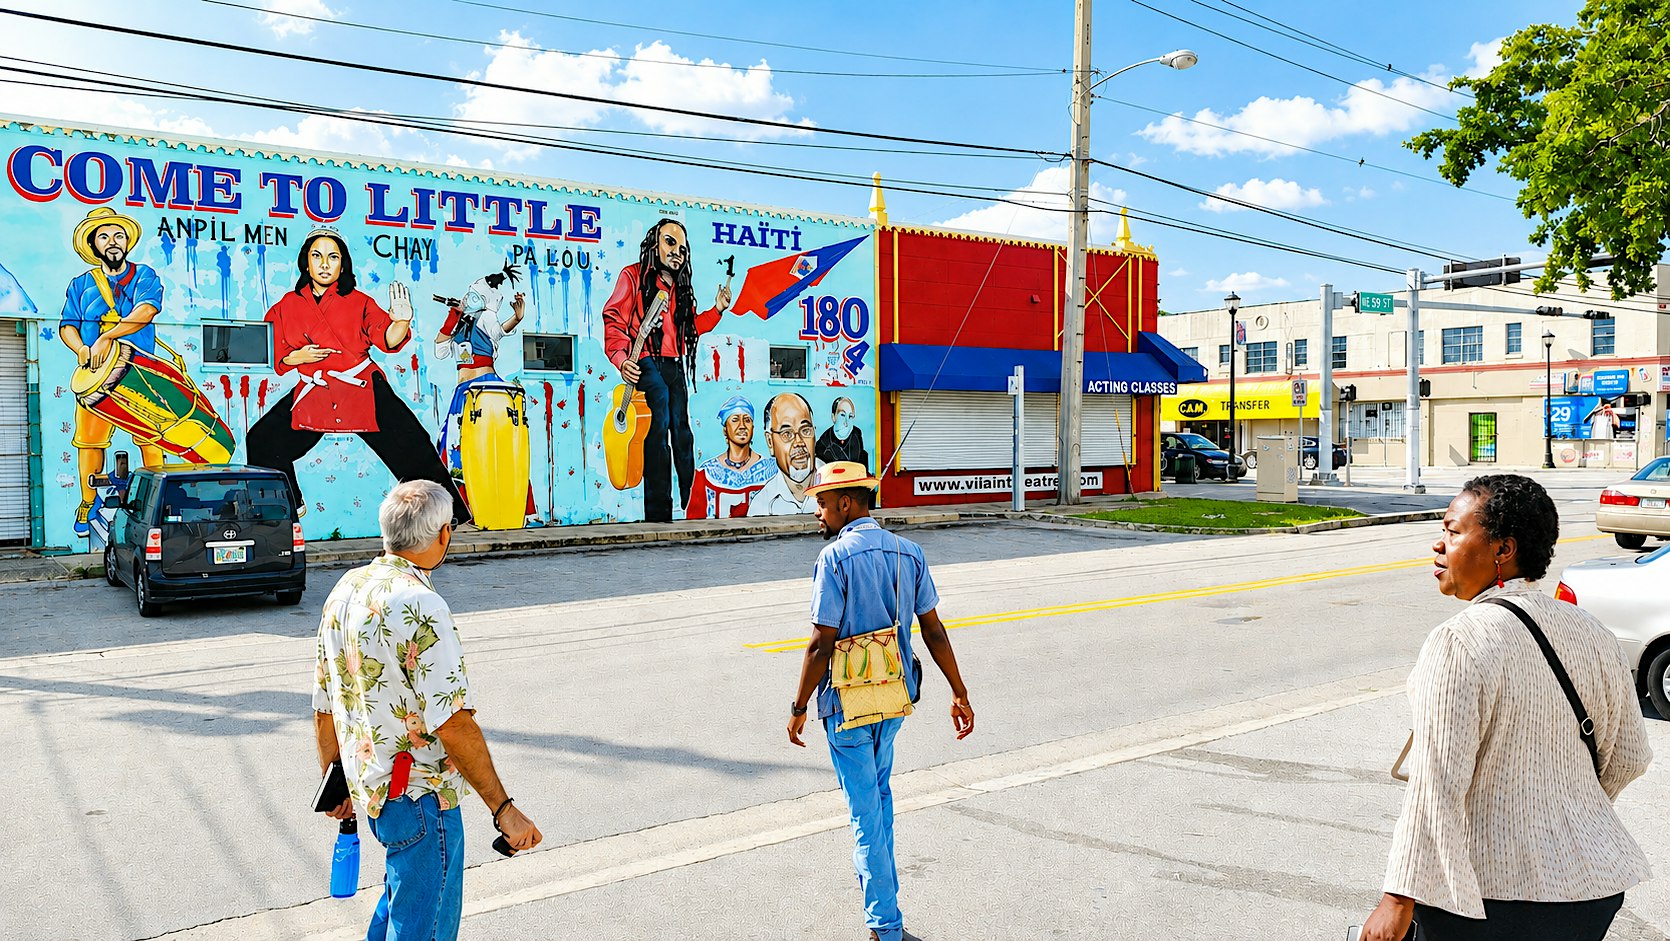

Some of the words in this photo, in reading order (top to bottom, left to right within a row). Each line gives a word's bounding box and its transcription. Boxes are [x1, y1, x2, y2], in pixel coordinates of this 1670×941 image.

[7, 144, 242, 214] COME
[259, 171, 348, 223] TO
[364, 182, 601, 243] LITTLE
[244, 223, 288, 247] MEN
[373, 234, 432, 261] CHAY
[512, 244, 537, 266] PA
[1371, 297, 1381, 308] 59
[1383, 297, 1391, 308] ST
[799, 295, 870, 342] 180
[842, 340, 870, 378] 4
[1087, 380, 1128, 393] ACTING
[1131, 381, 1176, 394] CLASSES
[1551, 406, 1571, 422] 29
